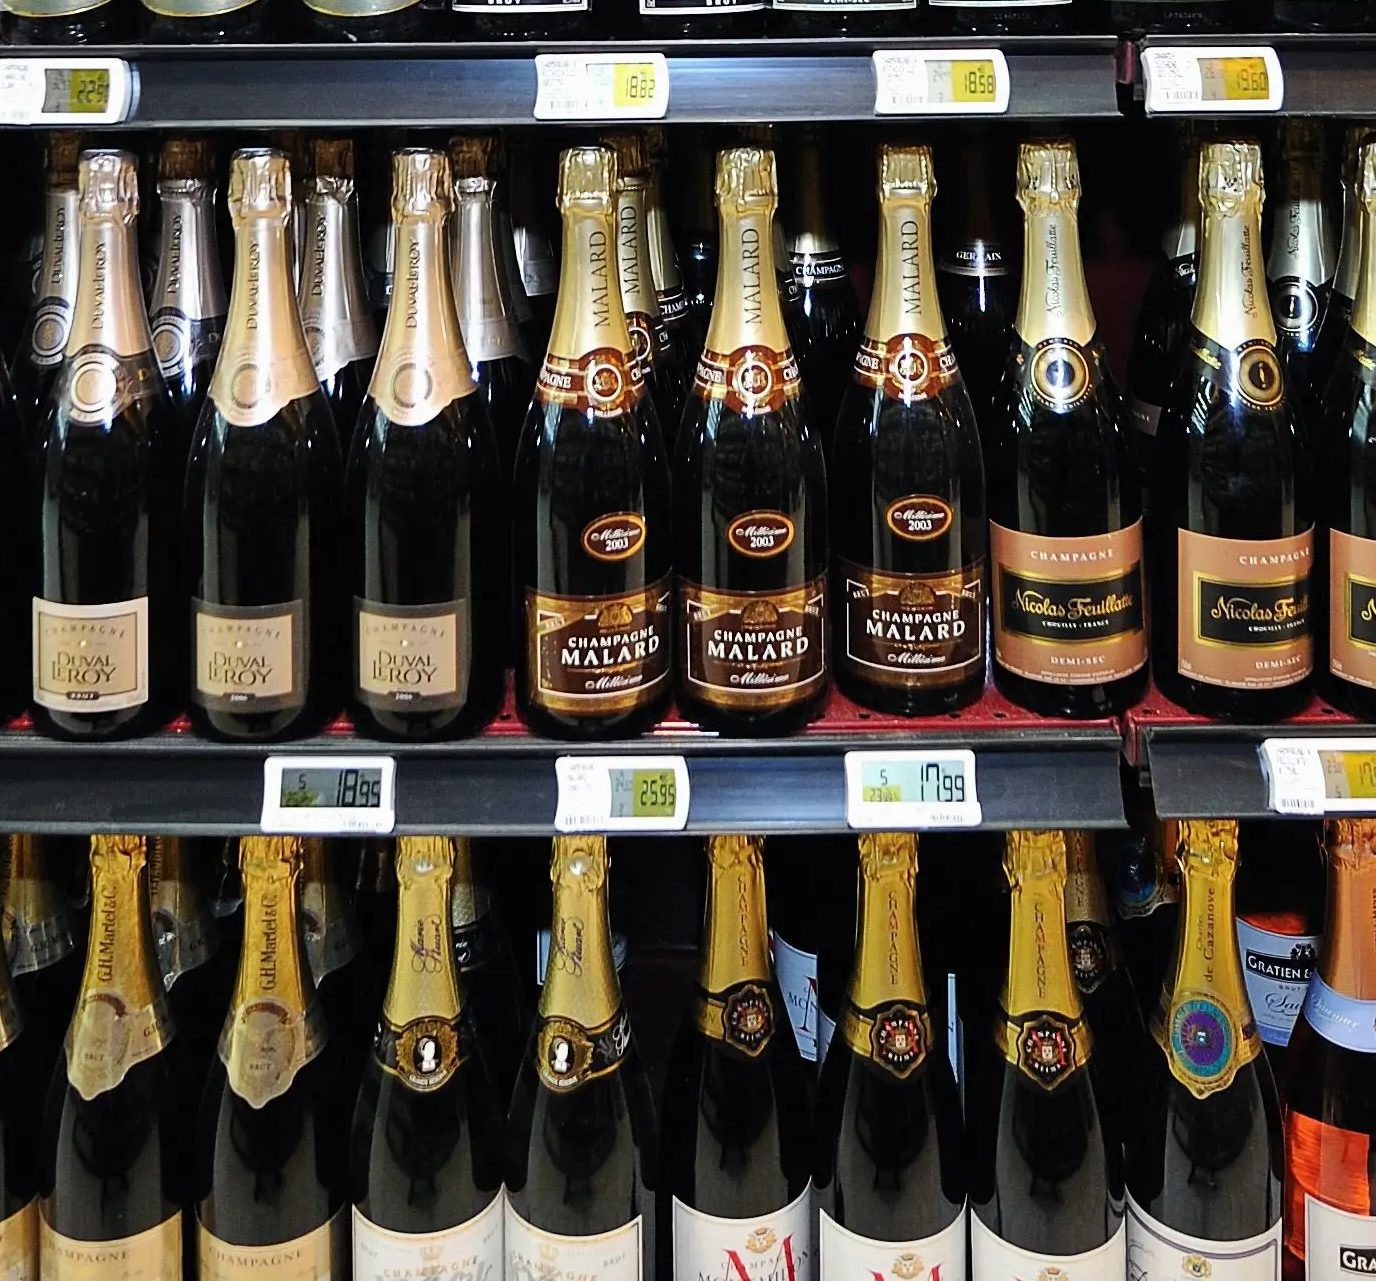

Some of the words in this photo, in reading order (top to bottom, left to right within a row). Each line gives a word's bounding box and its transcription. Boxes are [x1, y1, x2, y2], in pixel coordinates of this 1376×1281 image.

[593, 229, 612, 328] MALARD
[744, 227, 761, 325] MALARD
[605, 538, 629, 551] 2003
[1030, 549, 1114, 562] CHAMPAGNE
[1013, 589, 1065, 615] Nicolas
[561, 635, 659, 666] MALARD
[567, 626, 654, 649] CHAMPAGNE
[1050, 655, 1106, 664] DEMI-SEC
[1203, 887, 1215, 961] Cazanove
[888, 891, 899, 986] CHAMPAGNE
[1247, 953, 1299, 981] GRATIEN
